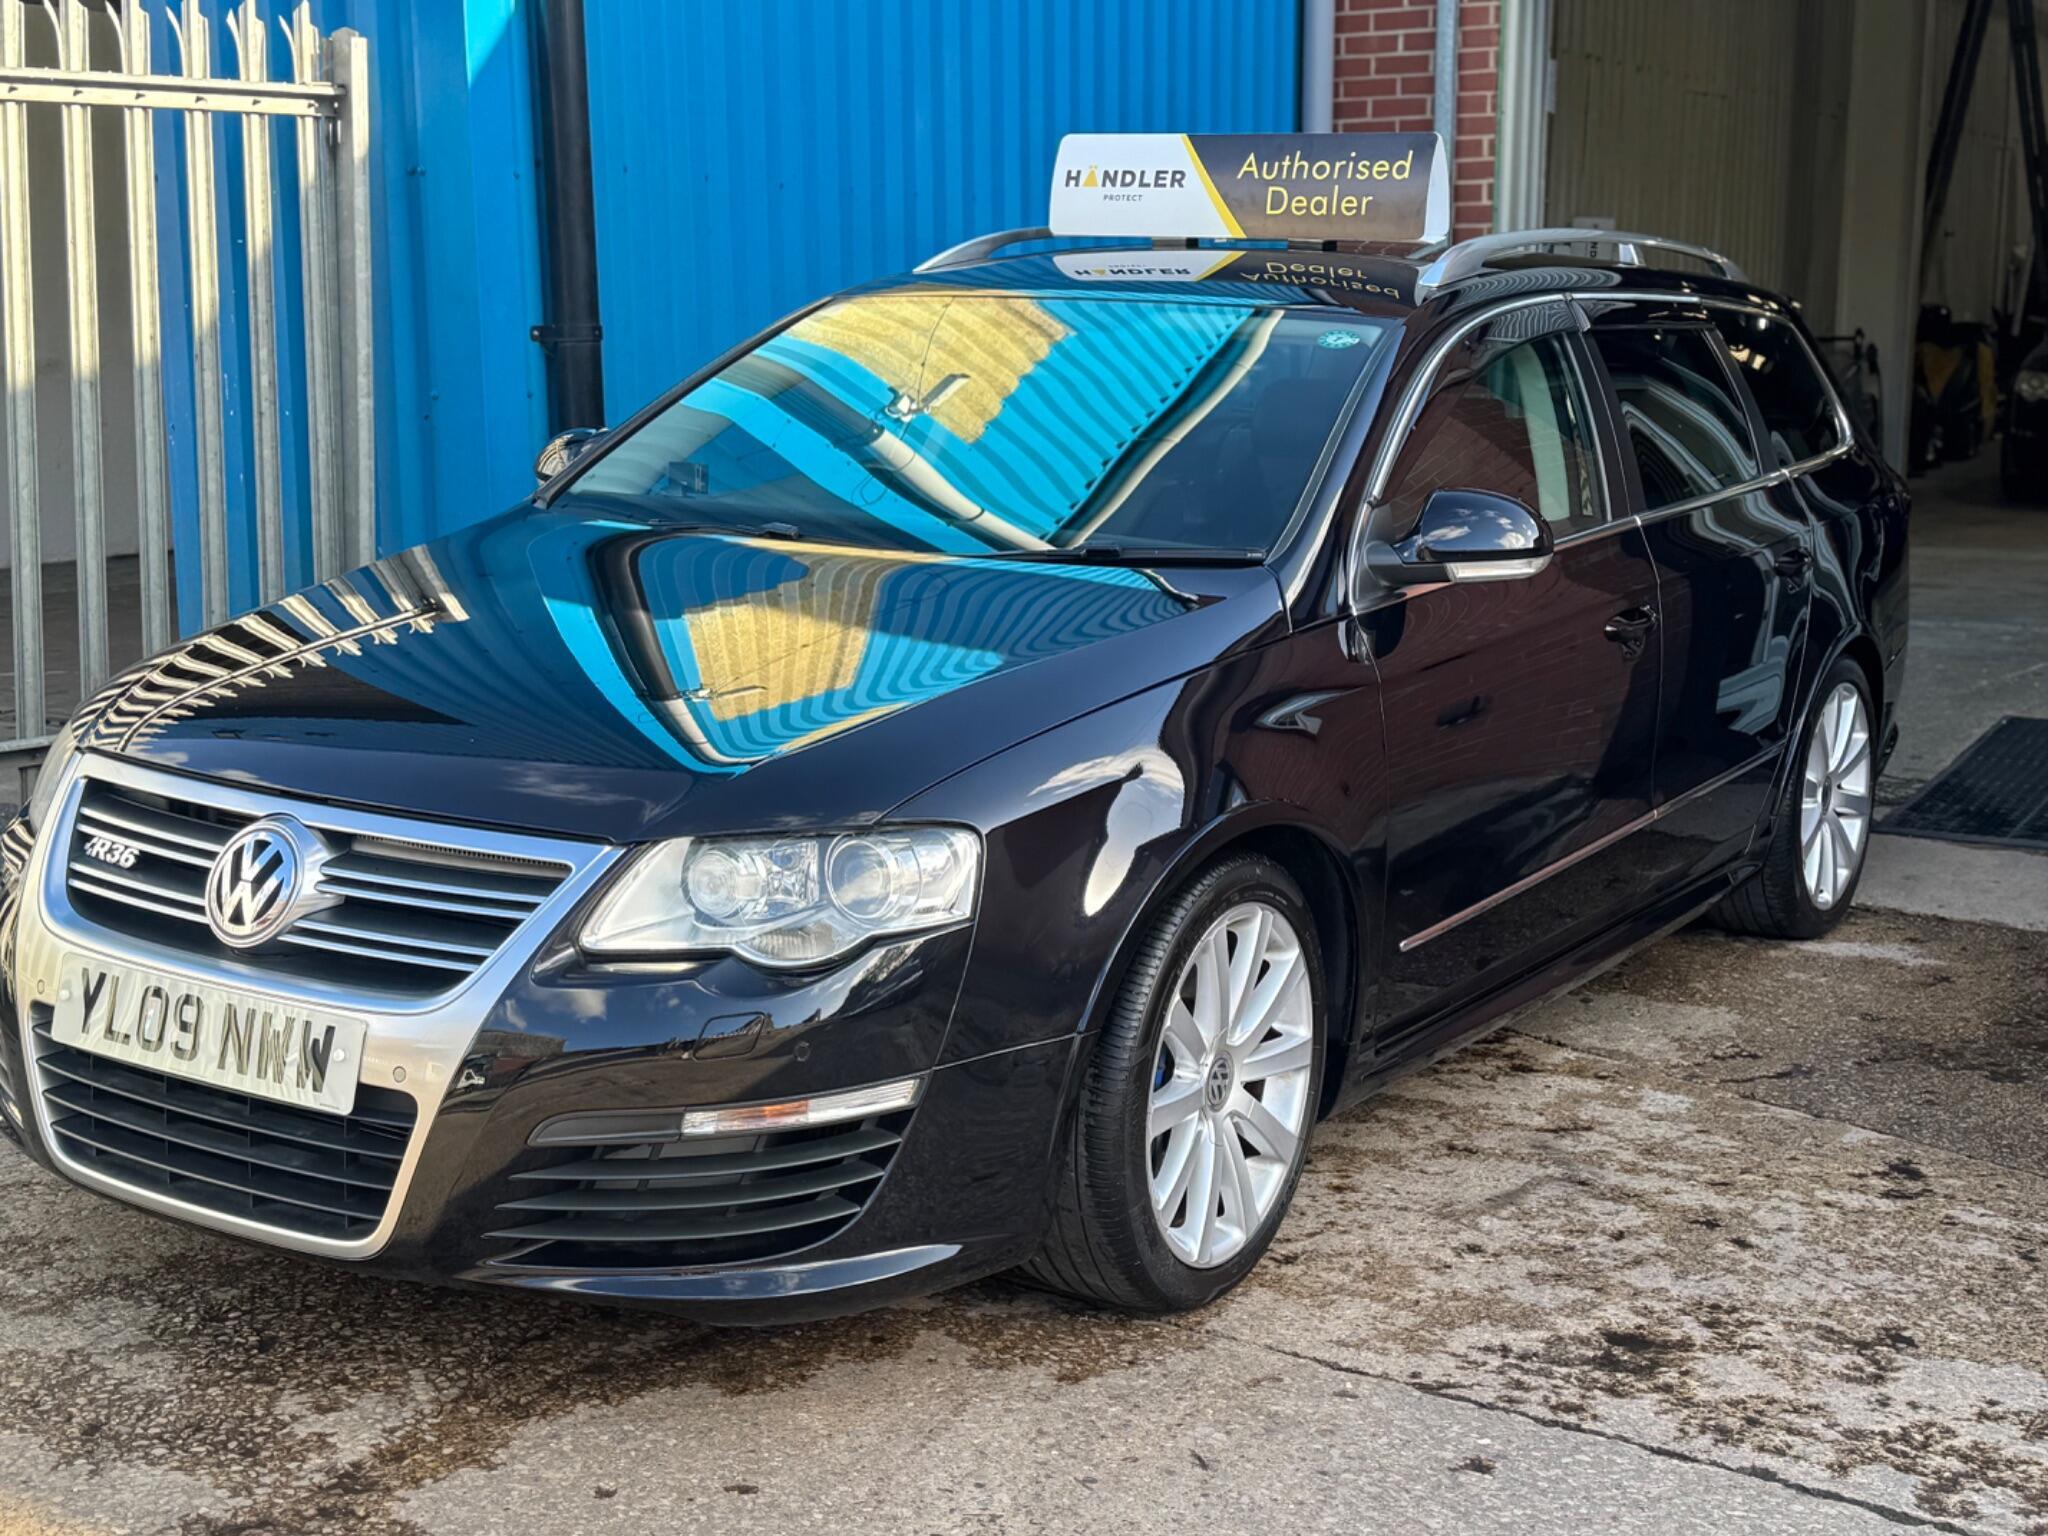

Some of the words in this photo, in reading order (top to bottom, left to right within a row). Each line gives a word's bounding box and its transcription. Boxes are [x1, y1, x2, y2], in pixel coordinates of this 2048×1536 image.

[1065, 164, 1187, 188] HÄNDLER
[1236, 150, 1413, 180] Authorised
[1103, 194, 1143, 202] PROTECT
[1265, 185, 1374, 216] Dealer
[81, 967, 203, 1062] YL09
